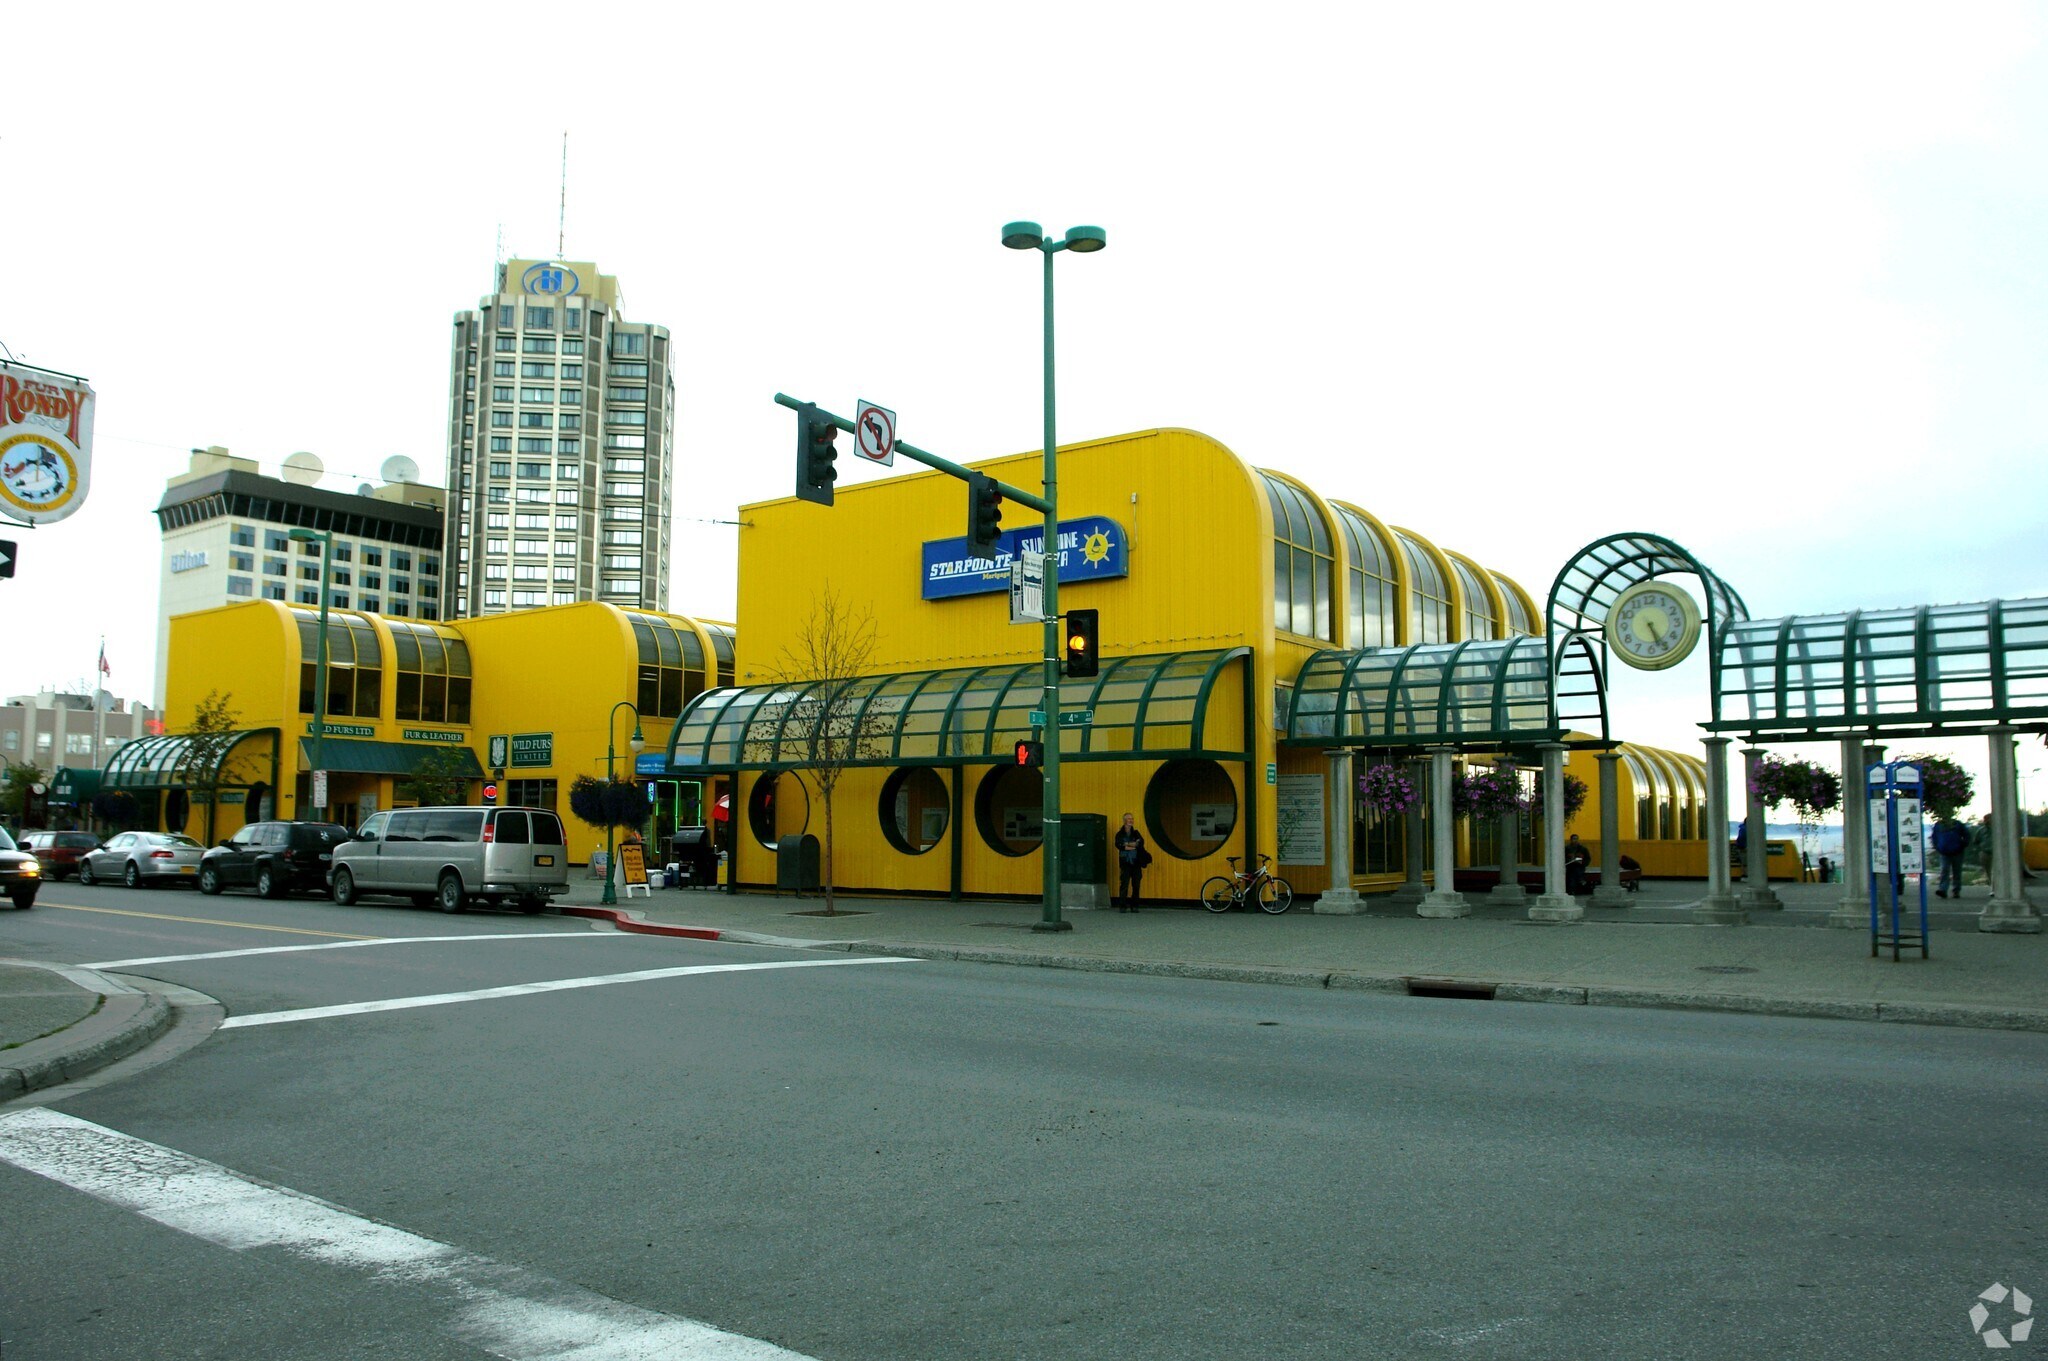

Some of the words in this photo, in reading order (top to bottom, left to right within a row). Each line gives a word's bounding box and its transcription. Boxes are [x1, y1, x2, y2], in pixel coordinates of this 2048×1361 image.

[23, 379, 60, 395] FUR
[0, 373, 87, 449] RONDY
[1021, 531, 1079, 554] SUNINE
[930, 553, 1013, 577] STARPOINTE
[1631, 599, 1642, 610] 11
[1643, 595, 1656, 606] 12
[1621, 609, 1634, 620] 10
[1669, 606, 1678, 616] 2
[1620, 622, 1629, 632] 9
[1673, 617, 1682, 628] 3
[1624, 634, 1633, 644] 8
[1669, 630, 1678, 640] 4
[1634, 643, 1642, 653] 7
[1647, 644, 1656, 655] 6
[333, 726, 354, 734] FURS
[405, 731, 421, 739] FUR
[429, 732, 463, 741] LEATHER
[513, 740, 531, 750] WILD
[532, 739, 552, 749] FURS
[515, 752, 547, 760] LIMITED
